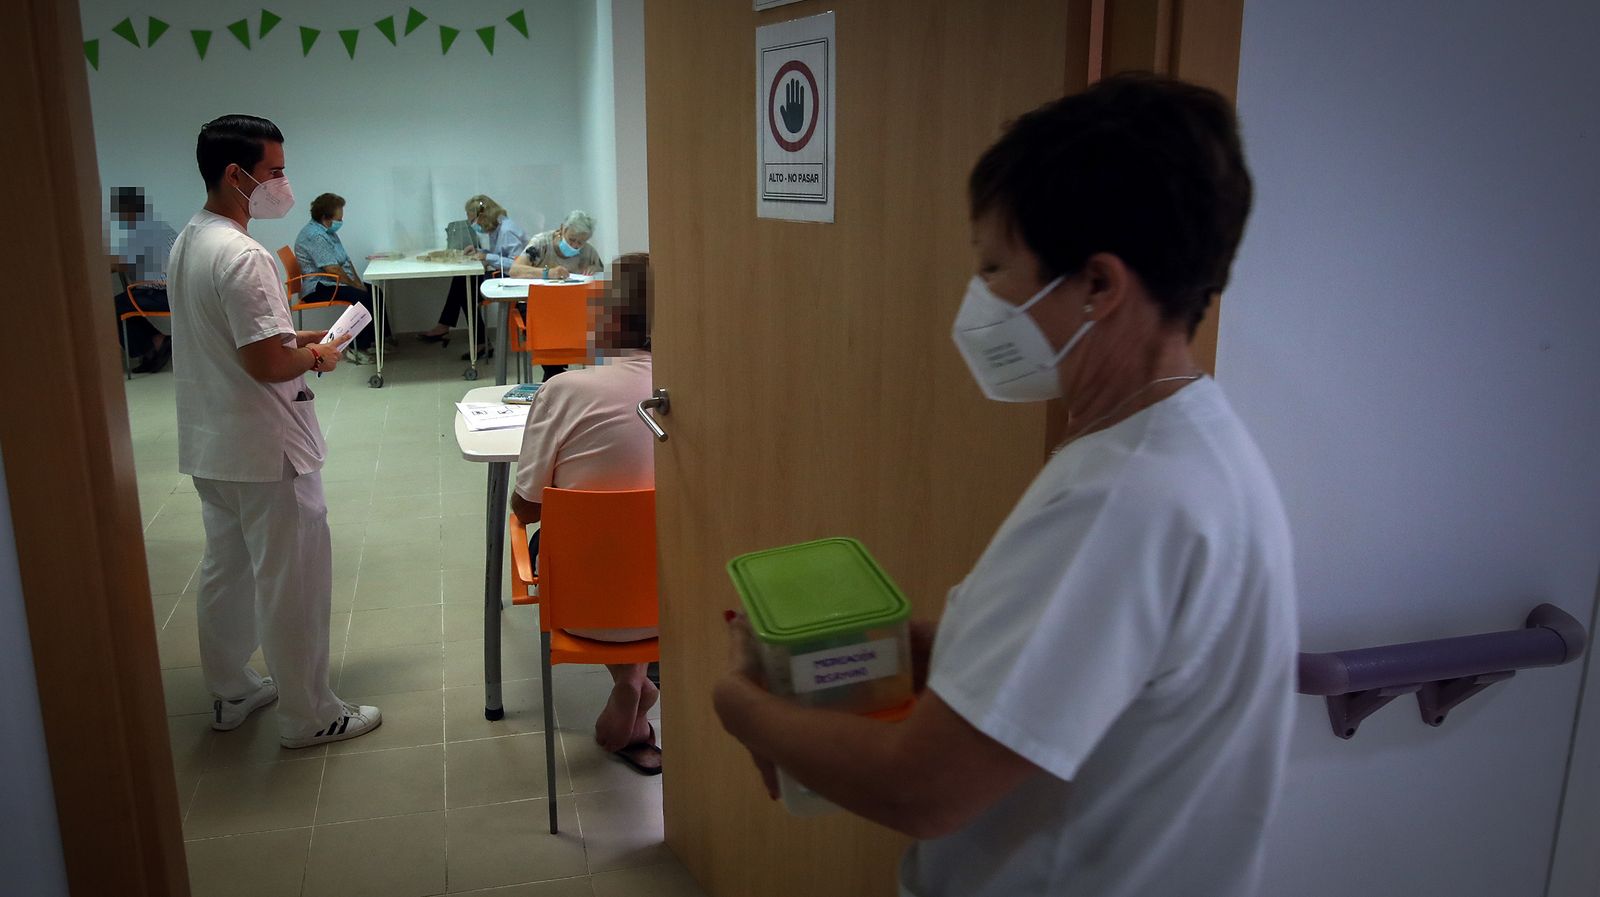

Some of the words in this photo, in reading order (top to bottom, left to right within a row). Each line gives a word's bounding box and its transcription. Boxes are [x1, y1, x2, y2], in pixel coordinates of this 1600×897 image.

[768, 173, 784, 182] ALTO
[788, 173, 798, 182] NO
[798, 173, 819, 183] PASAR
